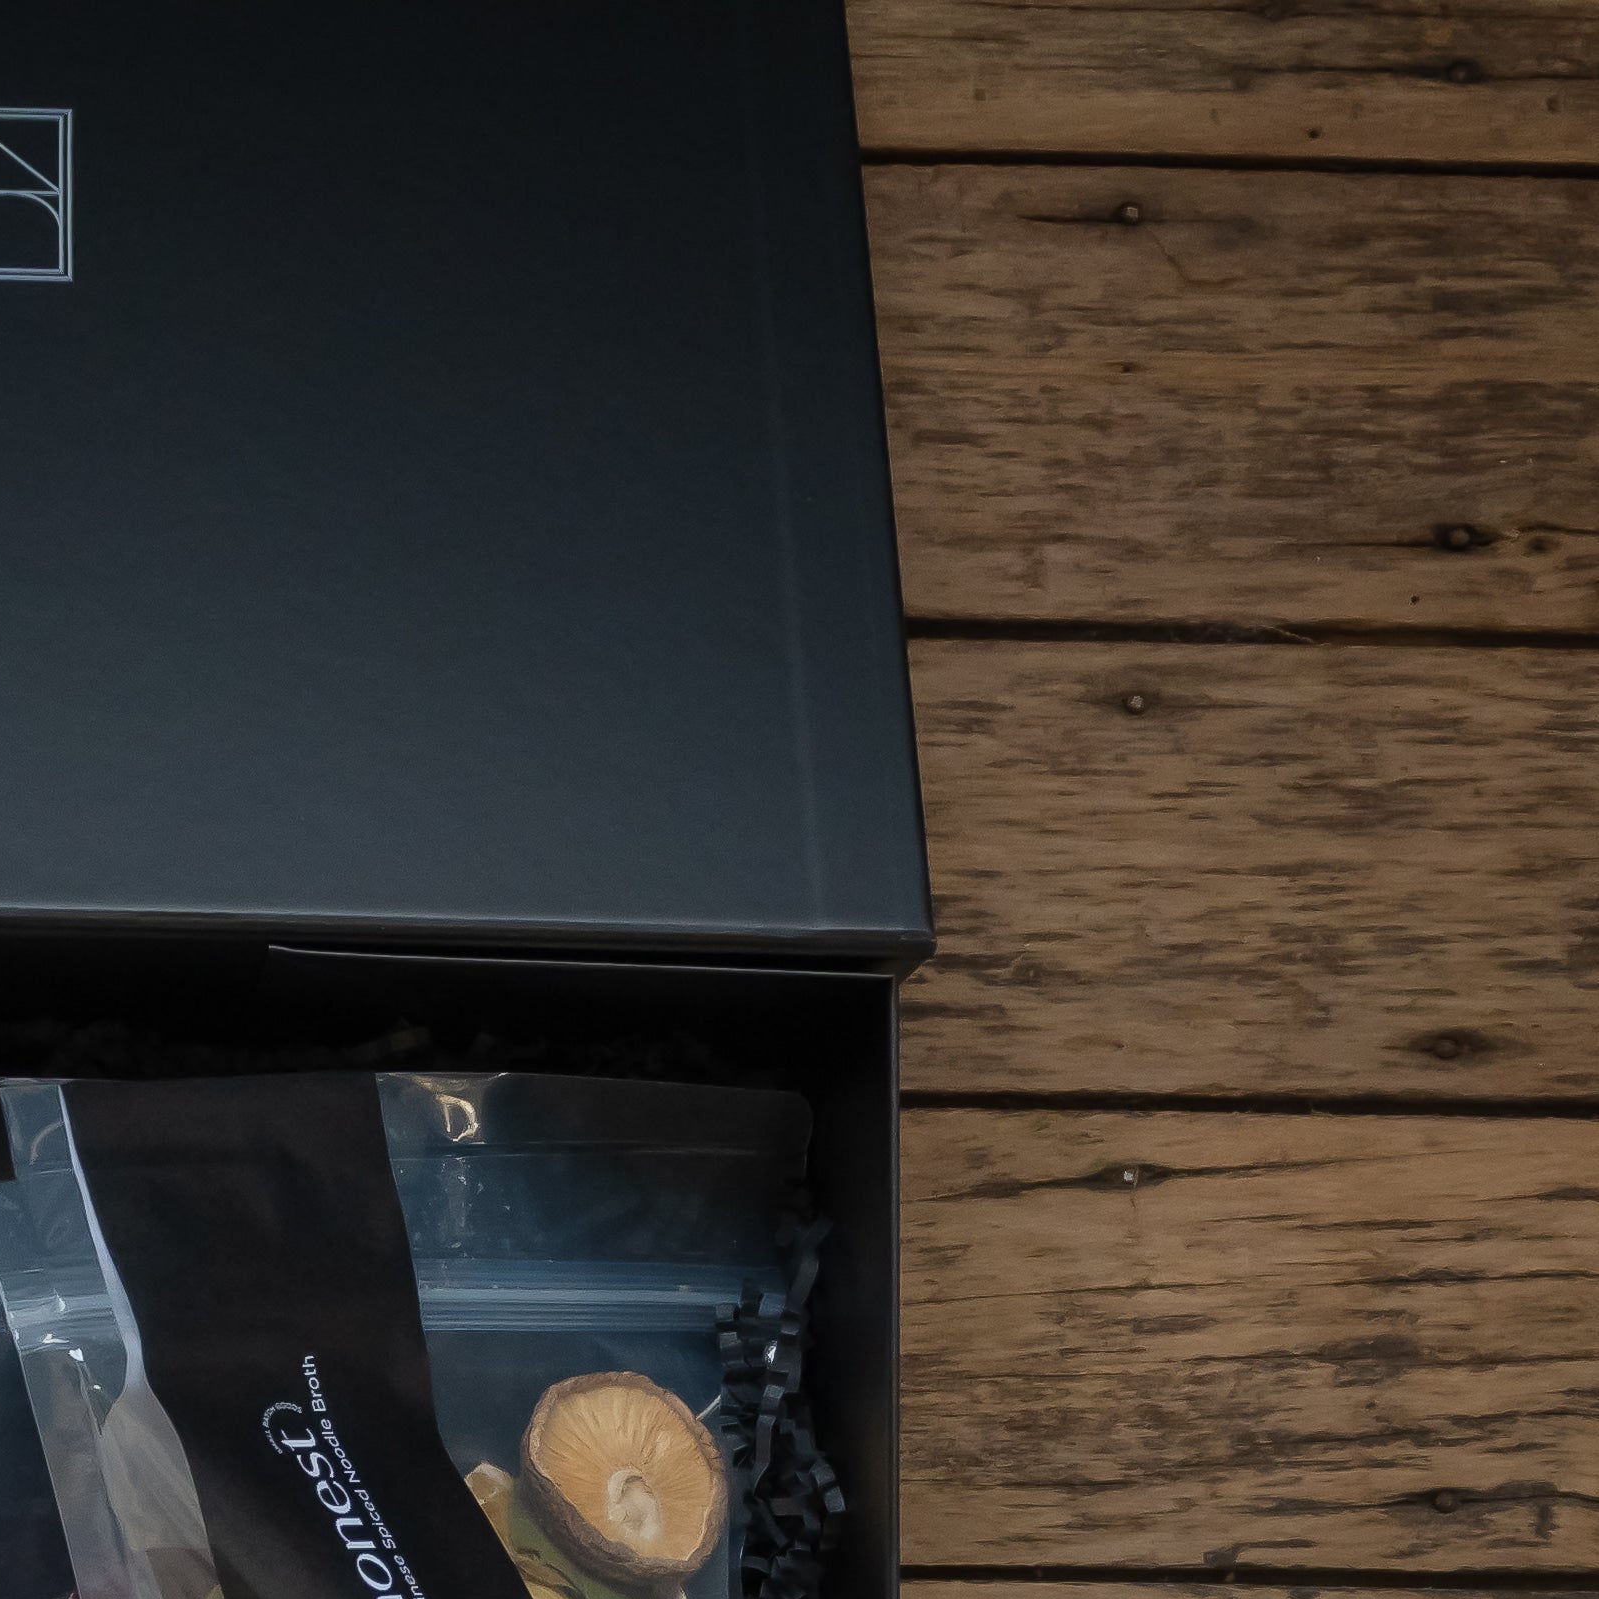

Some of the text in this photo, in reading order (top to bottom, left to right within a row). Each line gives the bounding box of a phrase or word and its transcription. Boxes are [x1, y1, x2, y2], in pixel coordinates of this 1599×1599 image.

[302, 1355, 327, 1412] Broth
[320, 1418, 361, 1483] Noodle
[354, 1489, 397, 1549] Spiced
